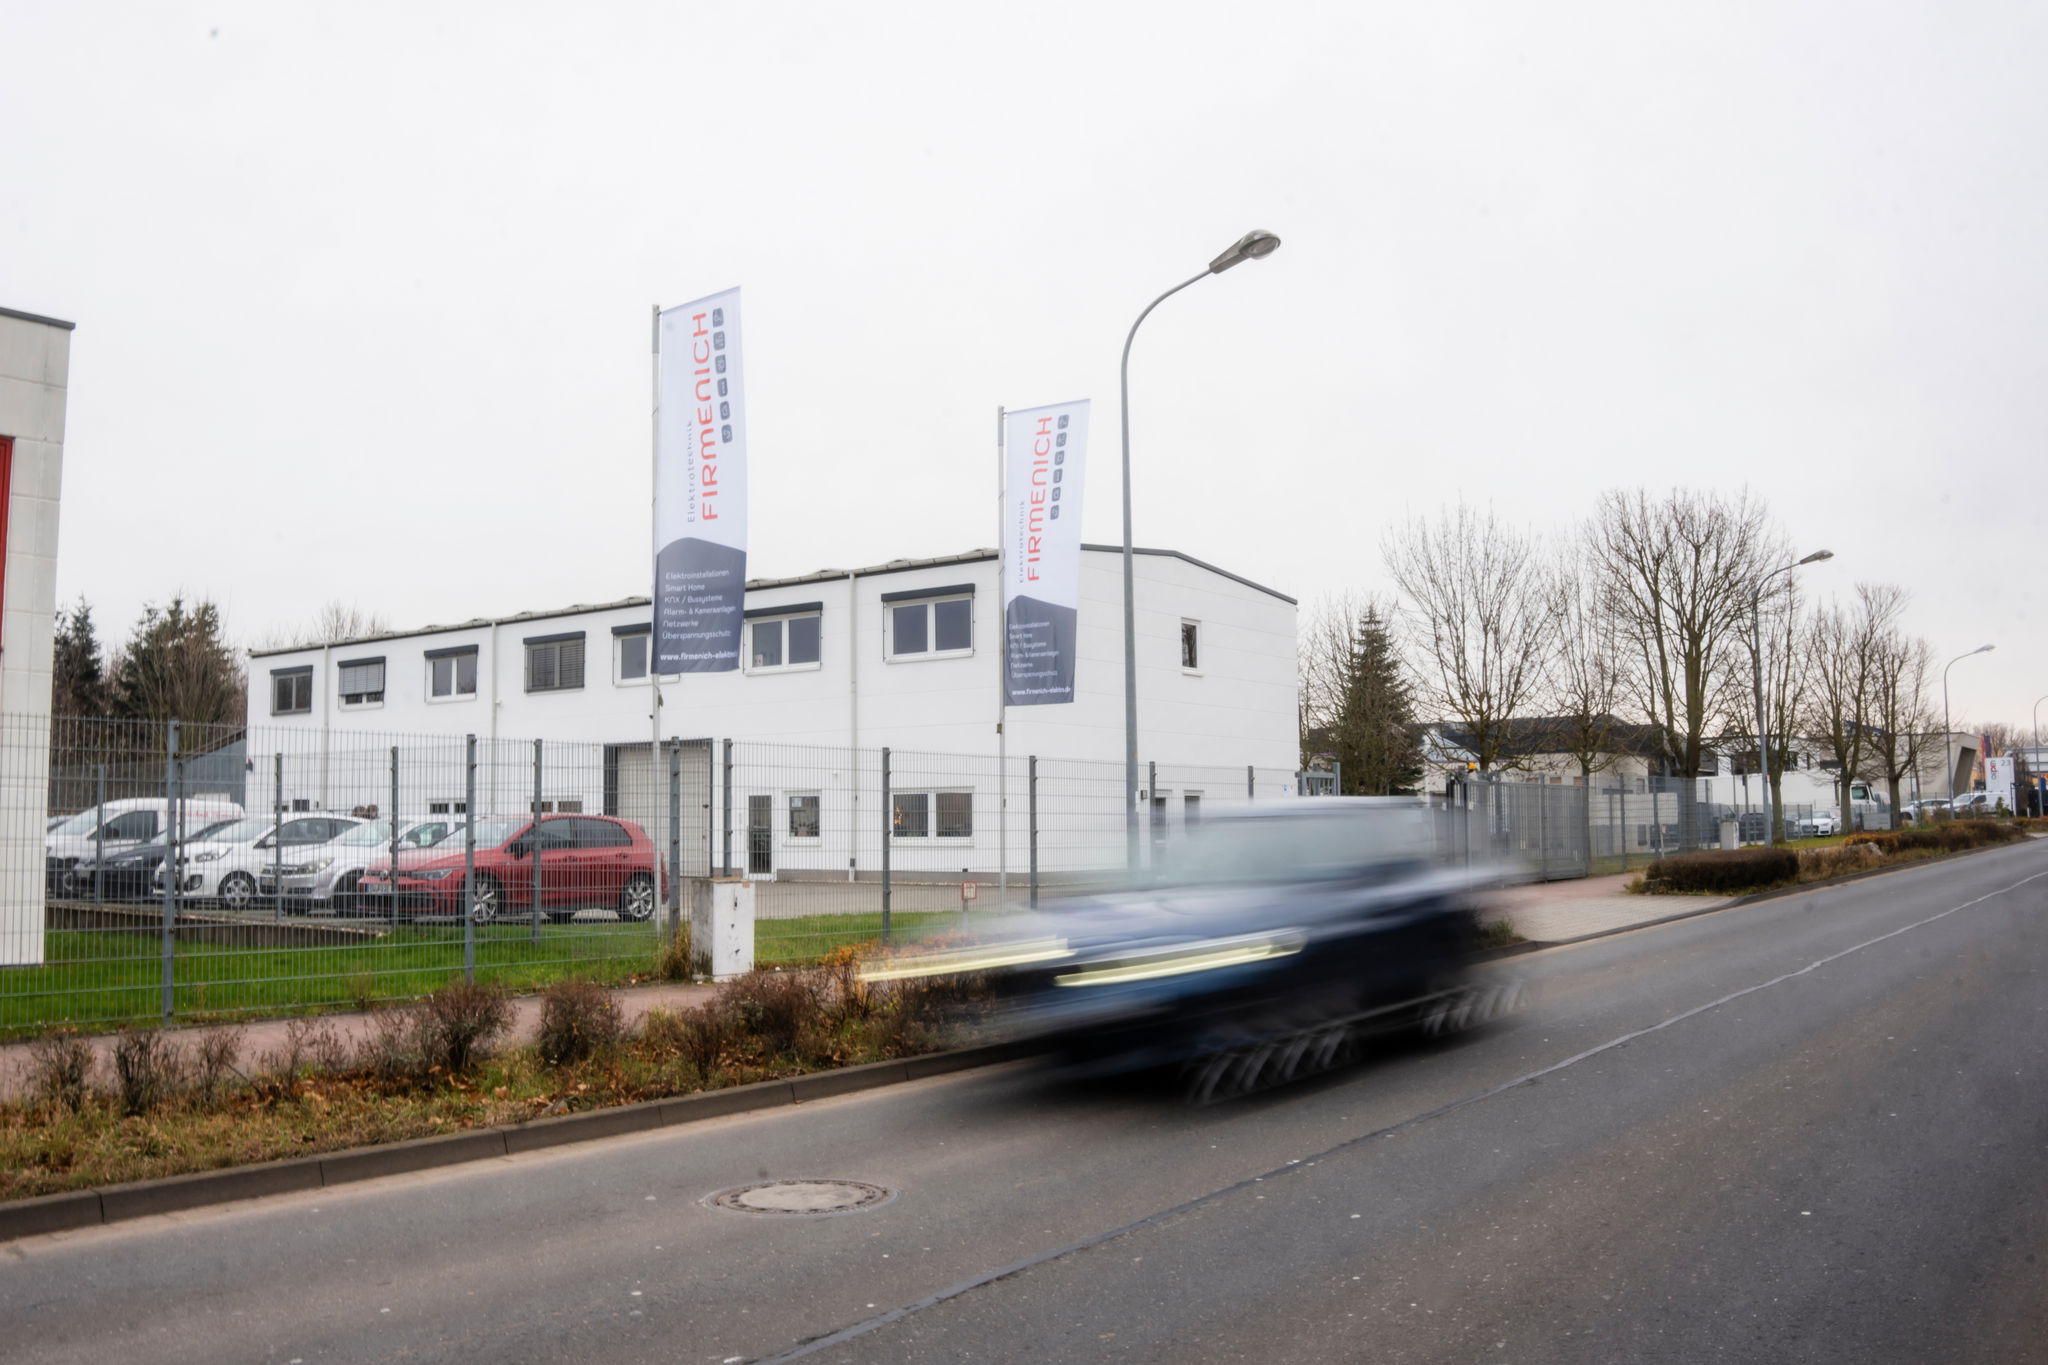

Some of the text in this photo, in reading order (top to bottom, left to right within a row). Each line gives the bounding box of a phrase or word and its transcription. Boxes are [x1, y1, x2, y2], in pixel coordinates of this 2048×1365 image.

[687, 421, 695, 523] Elektrotechnik
[692, 312, 718, 521] FIRMENICH
[1027, 417, 1053, 581] FIRMENICH
[665, 584, 686, 592] Smart
